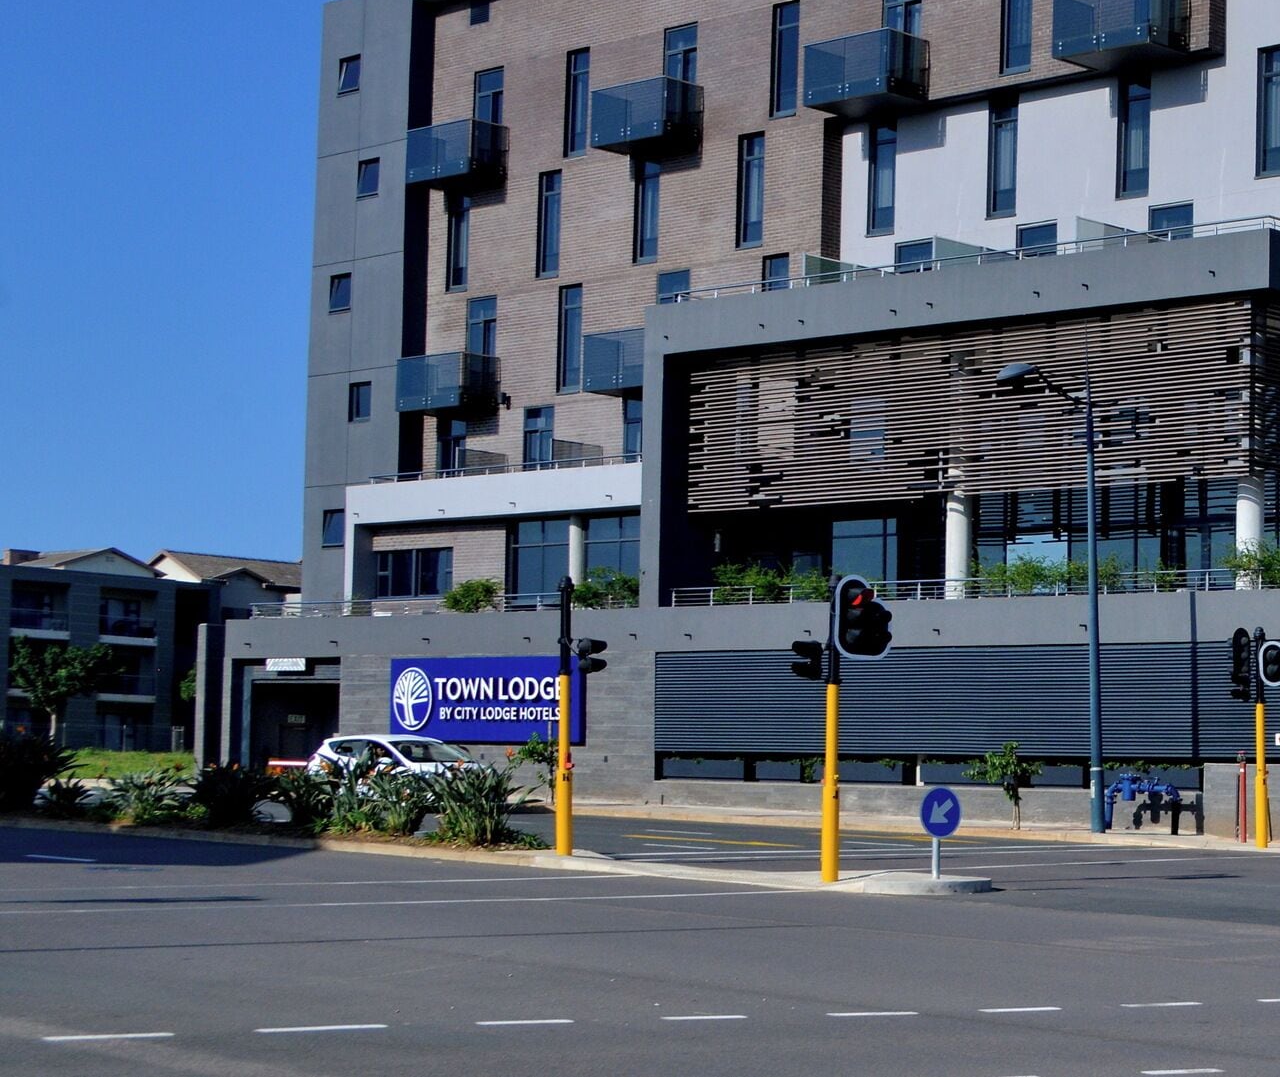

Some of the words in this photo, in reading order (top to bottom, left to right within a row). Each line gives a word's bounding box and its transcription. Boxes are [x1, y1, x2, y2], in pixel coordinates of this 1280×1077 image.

[433, 676, 494, 701] TOWN
[439, 707, 453, 720] BY
[454, 706, 479, 720] CITY
[480, 707, 517, 720] LODGE
[519, 707, 560, 721] HOTELS
